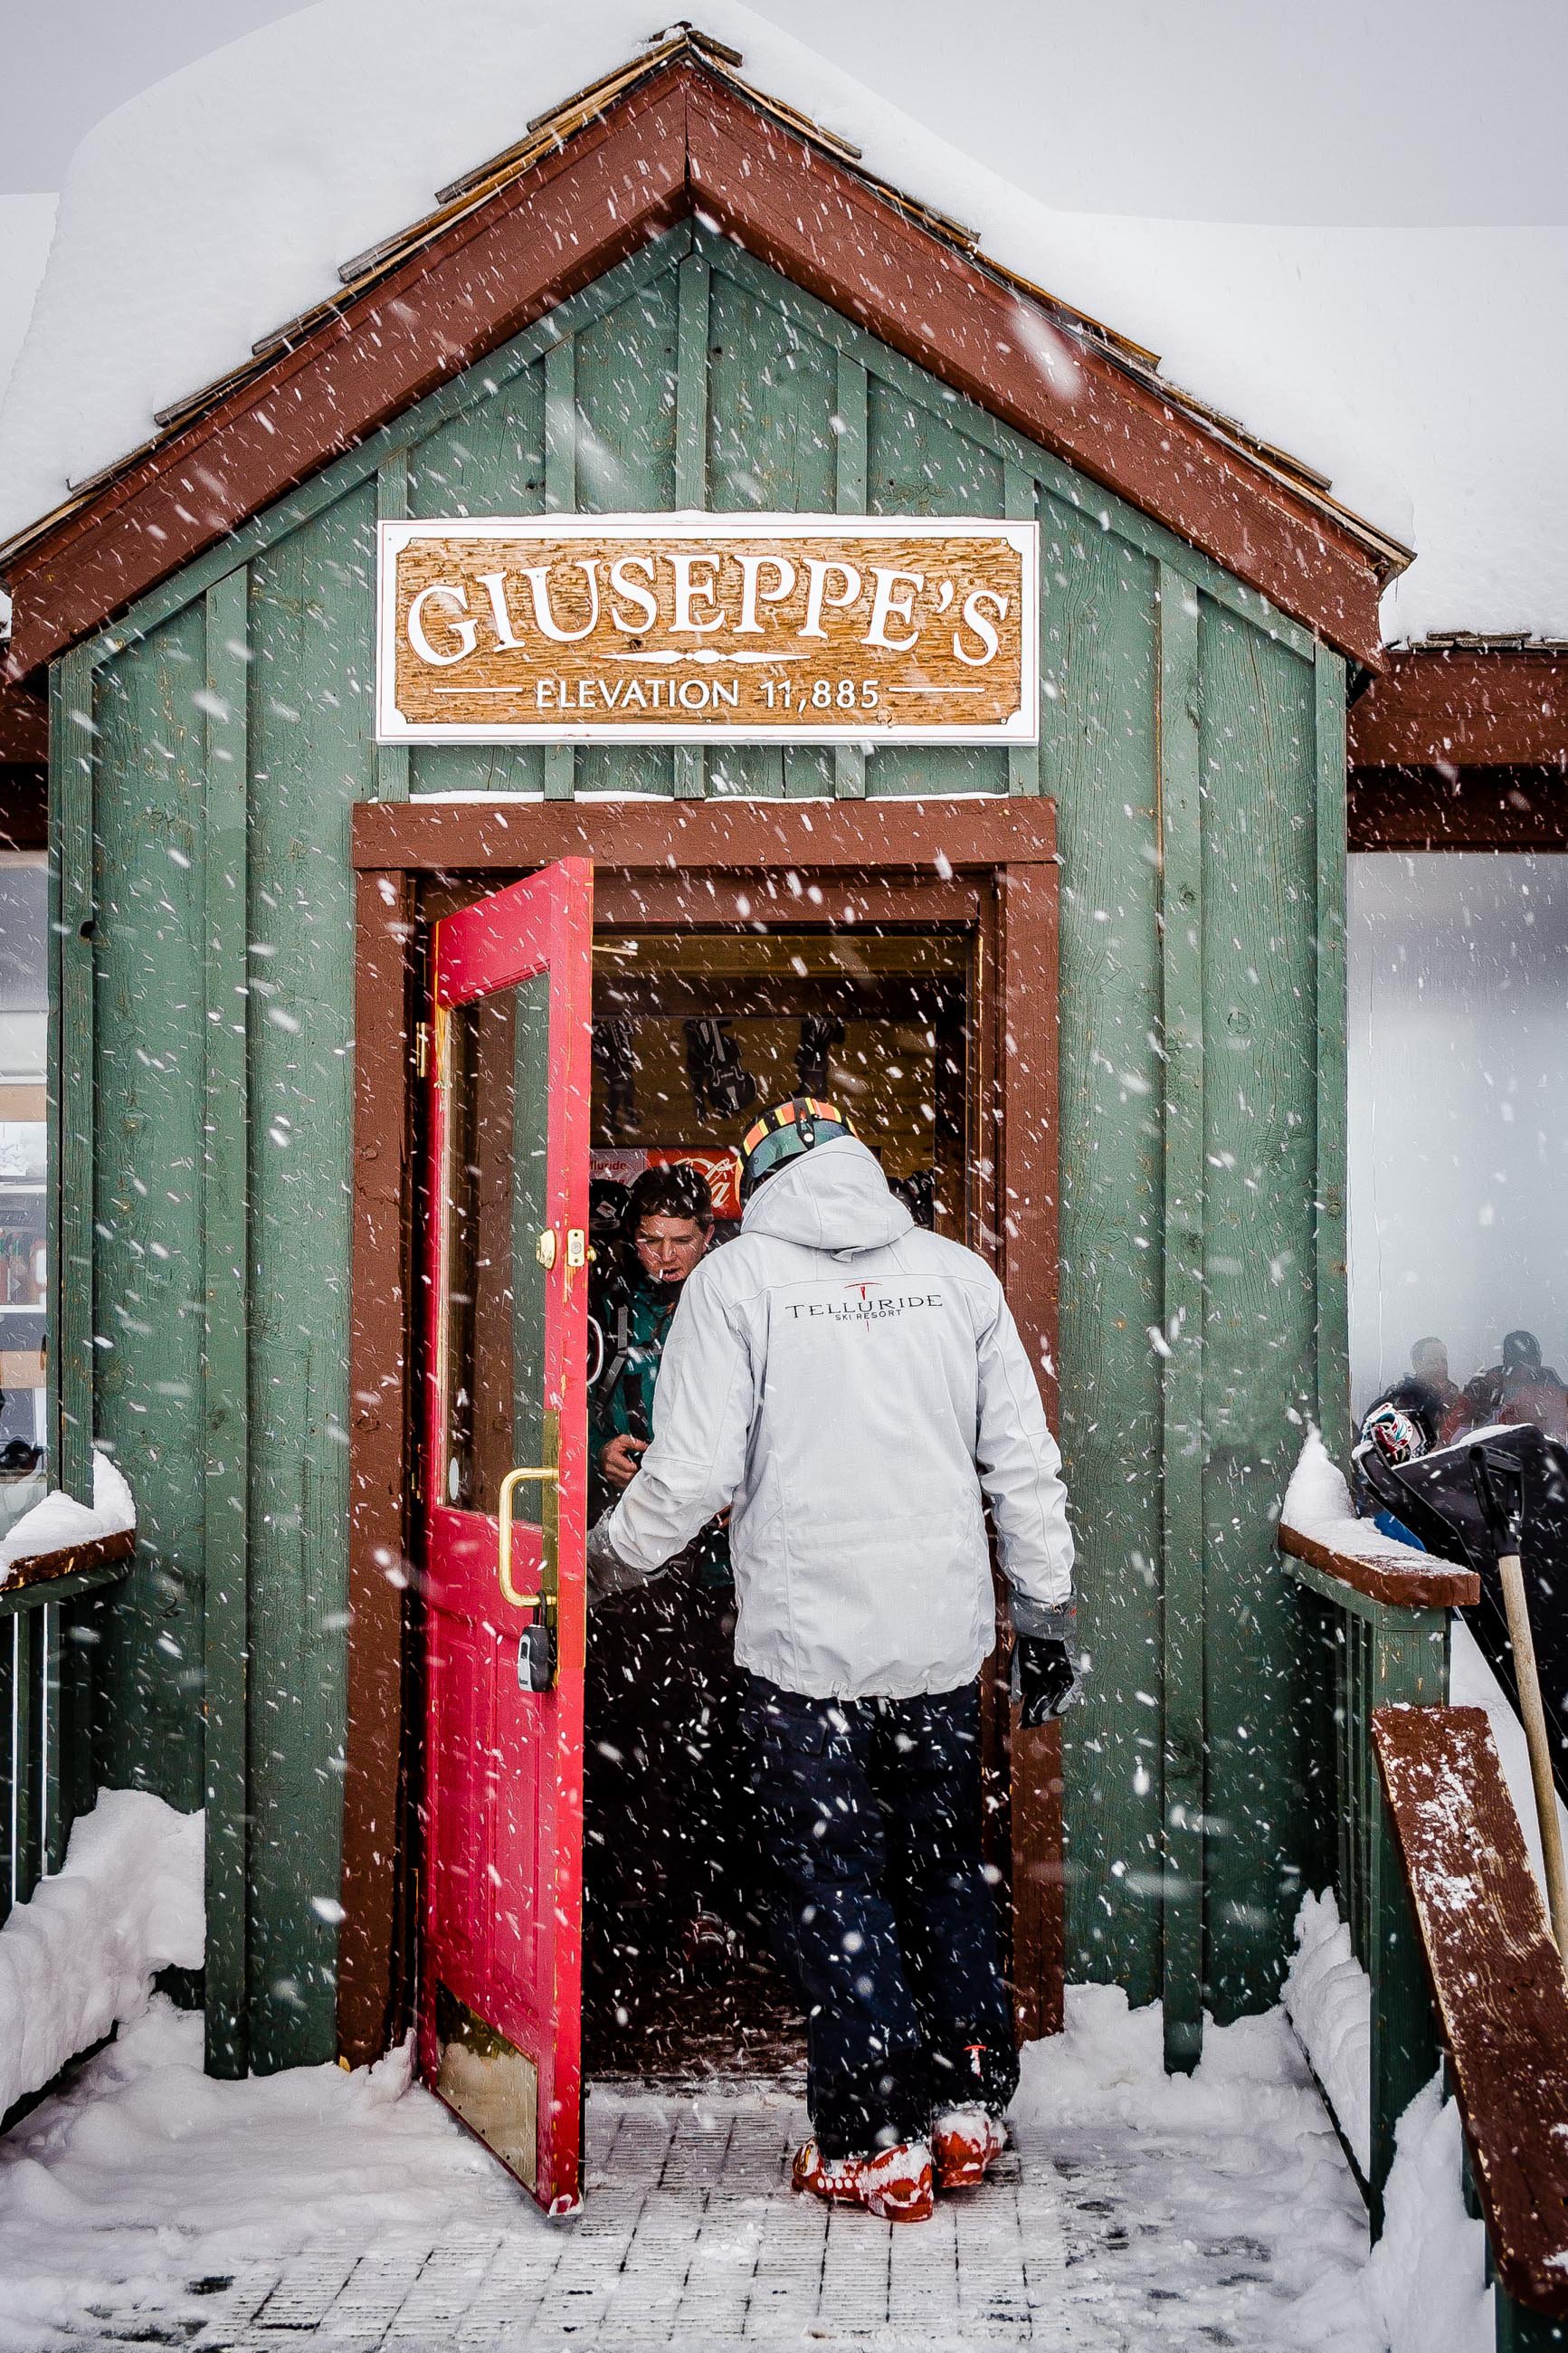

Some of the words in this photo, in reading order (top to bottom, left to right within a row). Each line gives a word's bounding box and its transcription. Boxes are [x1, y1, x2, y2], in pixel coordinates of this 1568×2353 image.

[405, 553, 1010, 667] GIUSEPPE'S
[537, 679, 739, 710] ELEVATION
[760, 679, 880, 713] 11,885
[590, 1159, 627, 1170] lluride
[784, 1294, 943, 1319] TELLURIDE
[834, 1313, 852, 1321] SKI
[856, 1309, 902, 1320] RESORT
